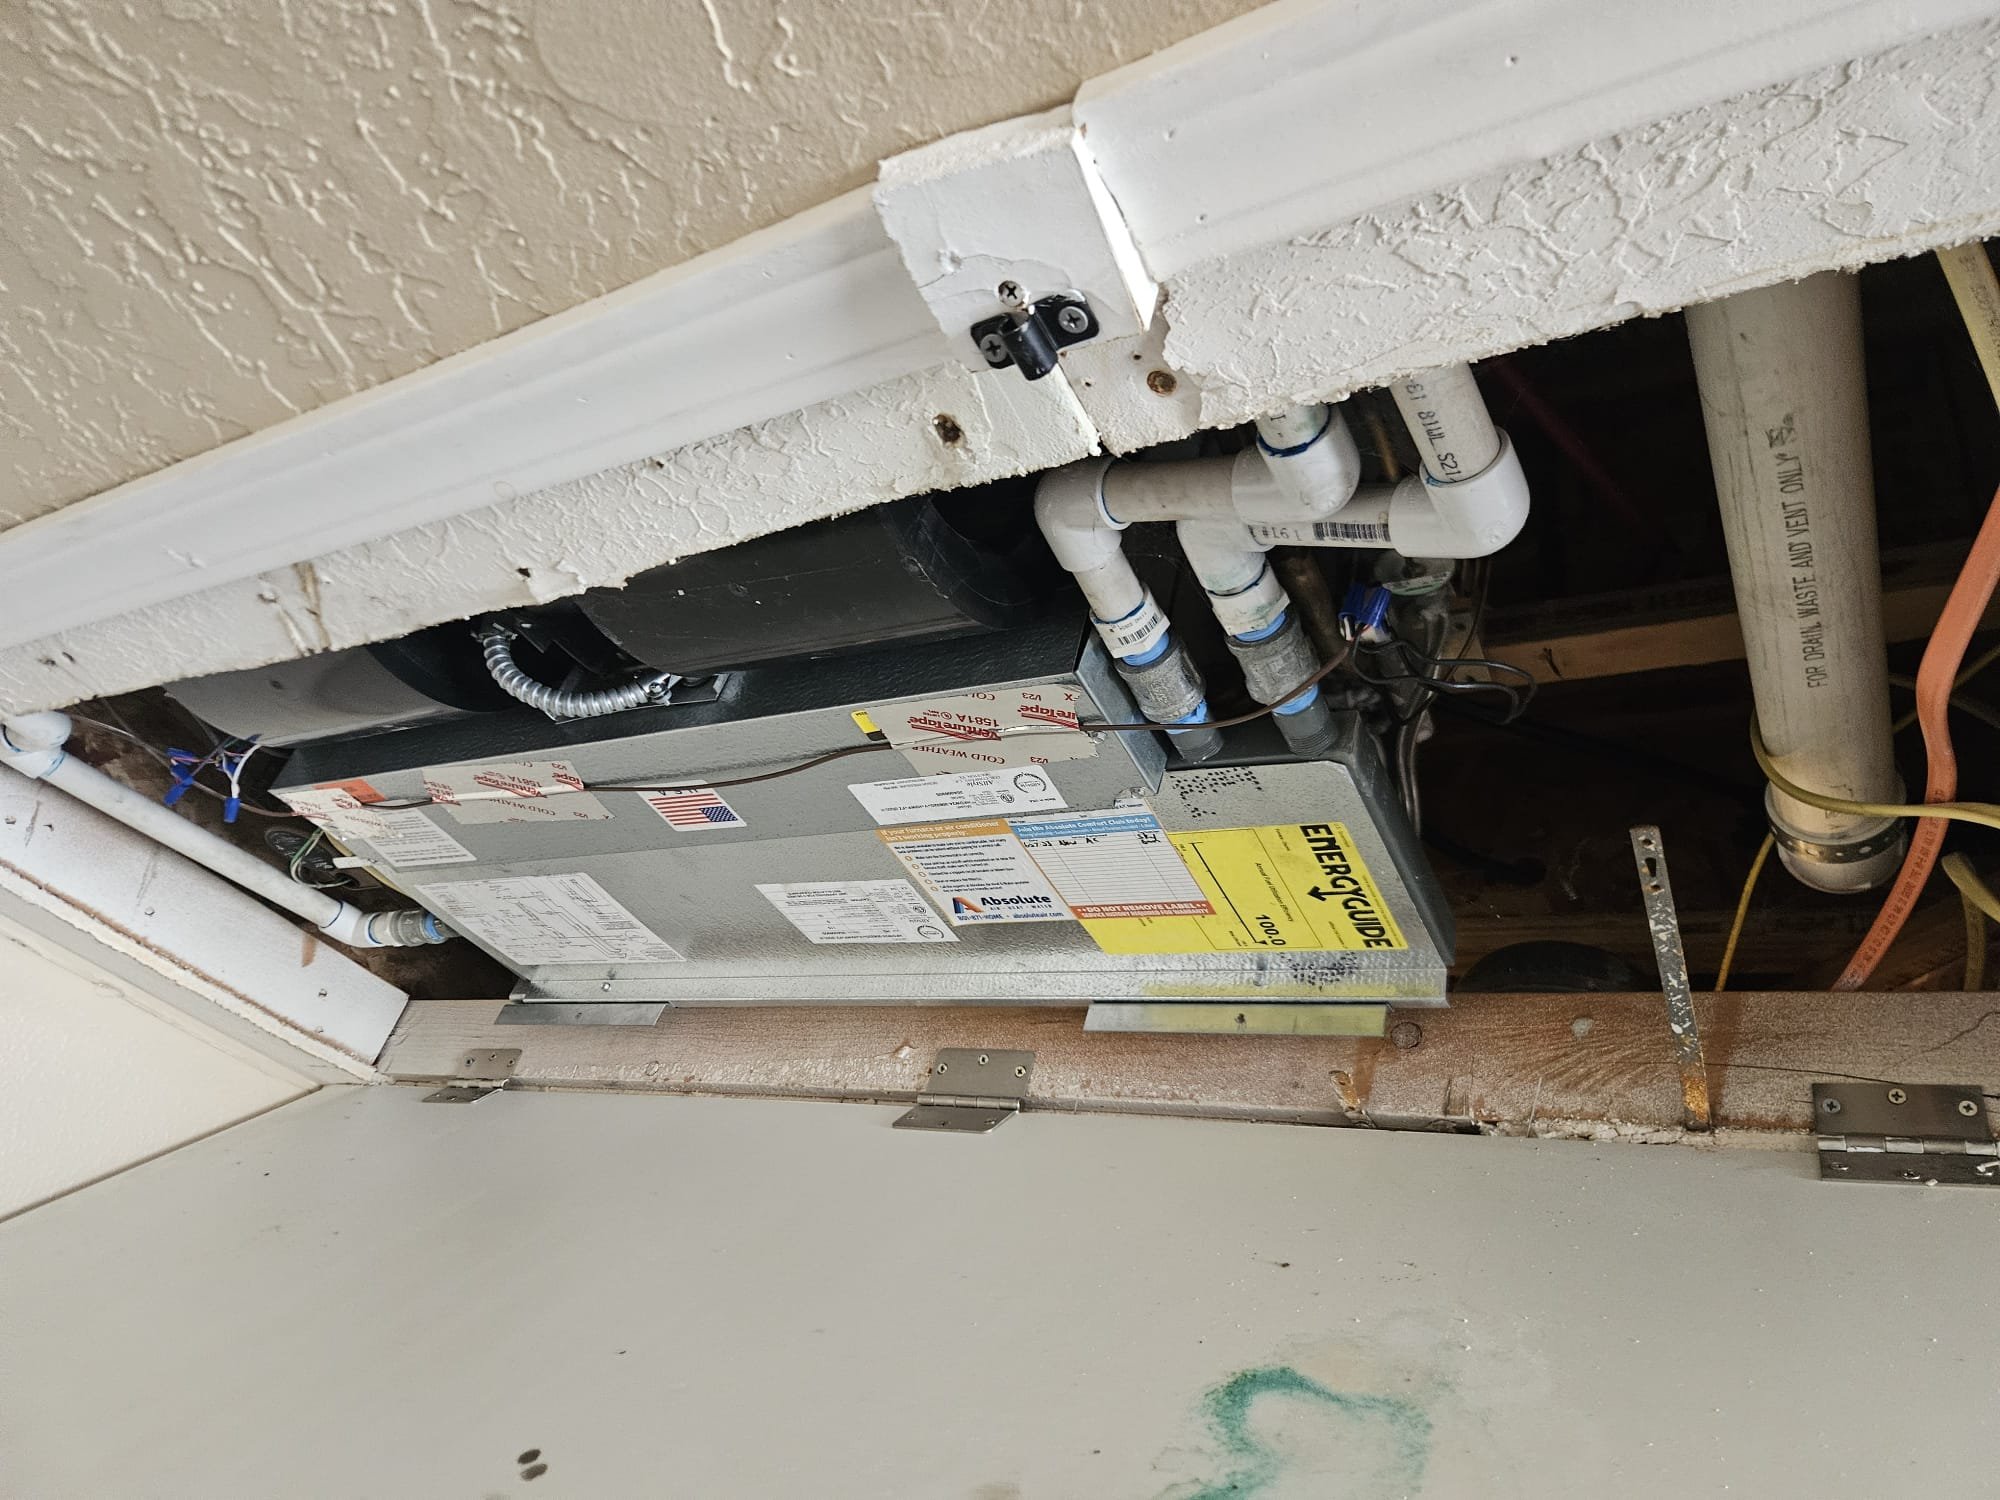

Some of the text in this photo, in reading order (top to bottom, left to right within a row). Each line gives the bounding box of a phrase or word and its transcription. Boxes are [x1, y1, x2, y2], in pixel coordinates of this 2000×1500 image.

[1776, 453, 1804, 494] ONLY
[1782, 502, 1809, 539] VENT
[1789, 541, 1813, 568] AND
[1793, 576, 1819, 619] WASTE
[1805, 666, 1827, 689] FOR
[1022, 692, 1042, 701] V23
[907, 716, 1001, 741] VentureTape
[956, 713, 1000, 728] 1581A
[911, 746, 1005, 765] COLD WEATHER
[1030, 756, 1049, 764] V23
[473, 775, 547, 799] VentureTape
[507, 774, 543, 788] 1581A
[528, 805, 556, 816] COLD
[1255, 863, 1293, 921] Annual Fuel Utilization Efficiency
[1299, 824, 1393, 948] ENERGYGUIDE
[981, 896, 1050, 905] Absolute
[1256, 915, 1285, 945] 100.0
